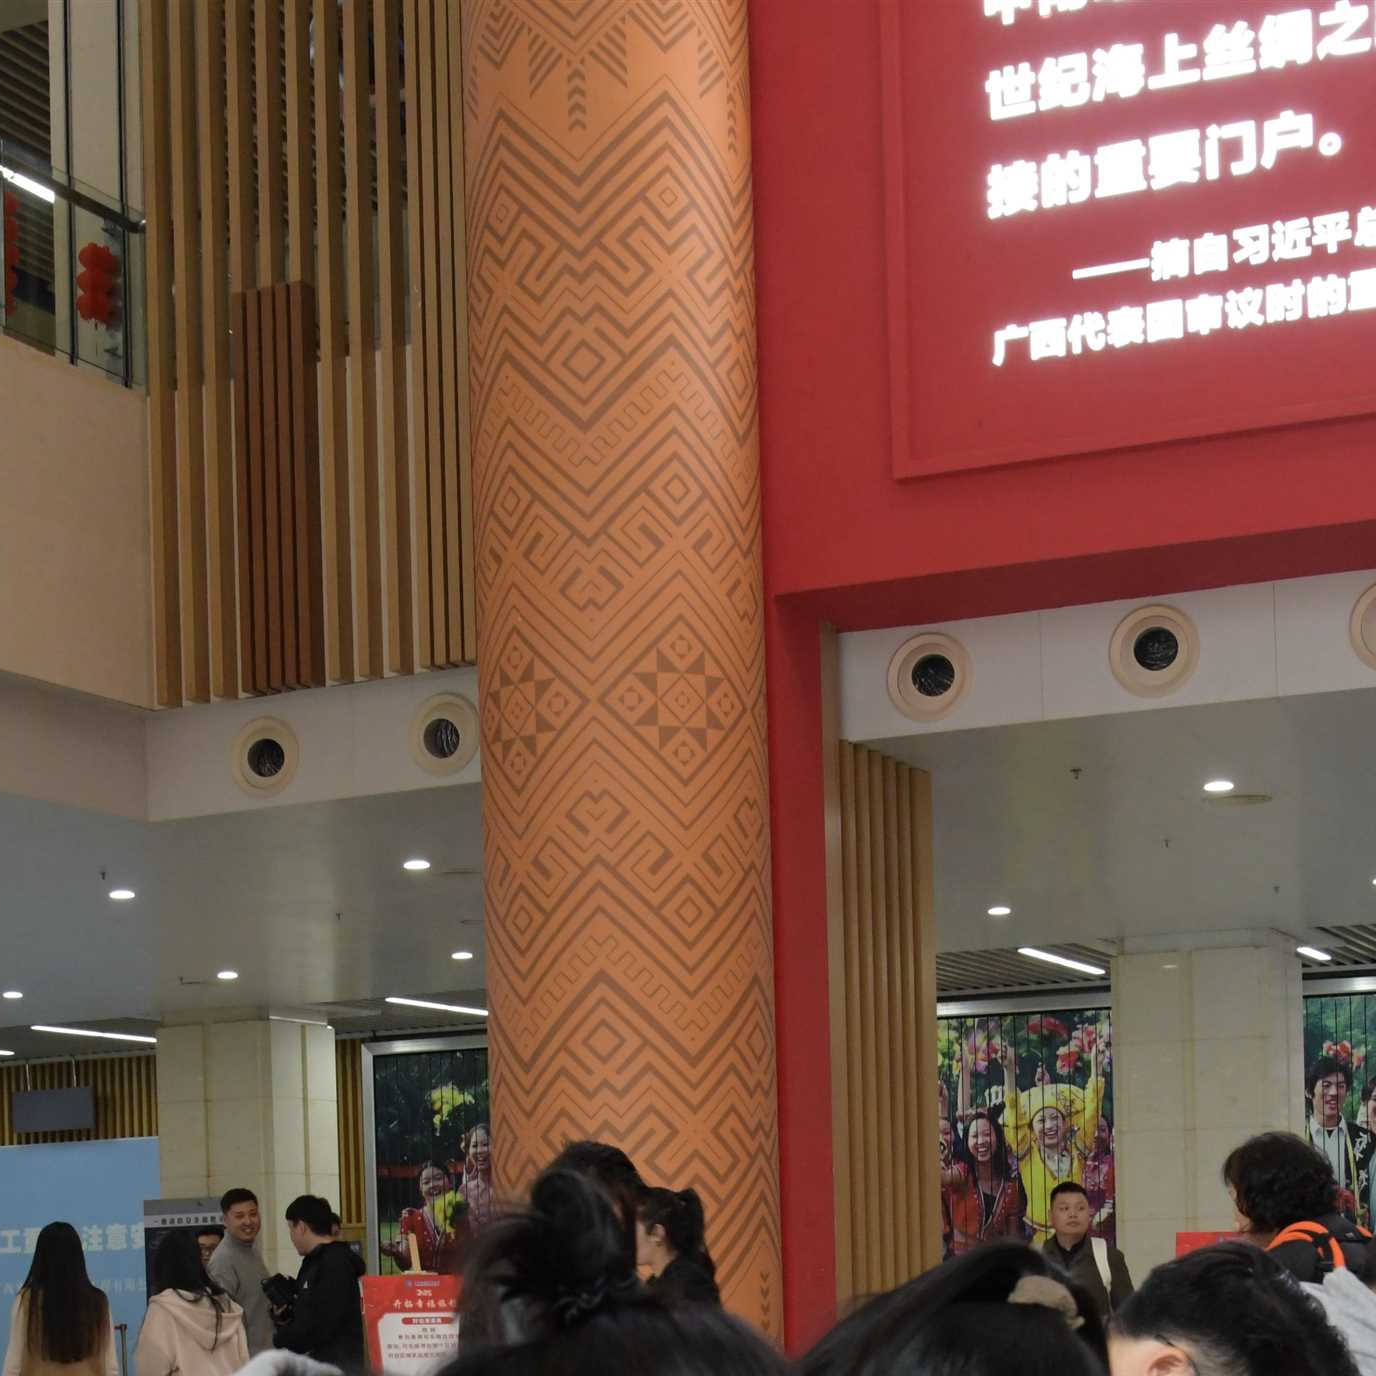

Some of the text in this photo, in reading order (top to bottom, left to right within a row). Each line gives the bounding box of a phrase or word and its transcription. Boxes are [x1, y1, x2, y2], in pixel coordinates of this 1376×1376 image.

[986, 109, 1343, 220] 接的重要门户。
